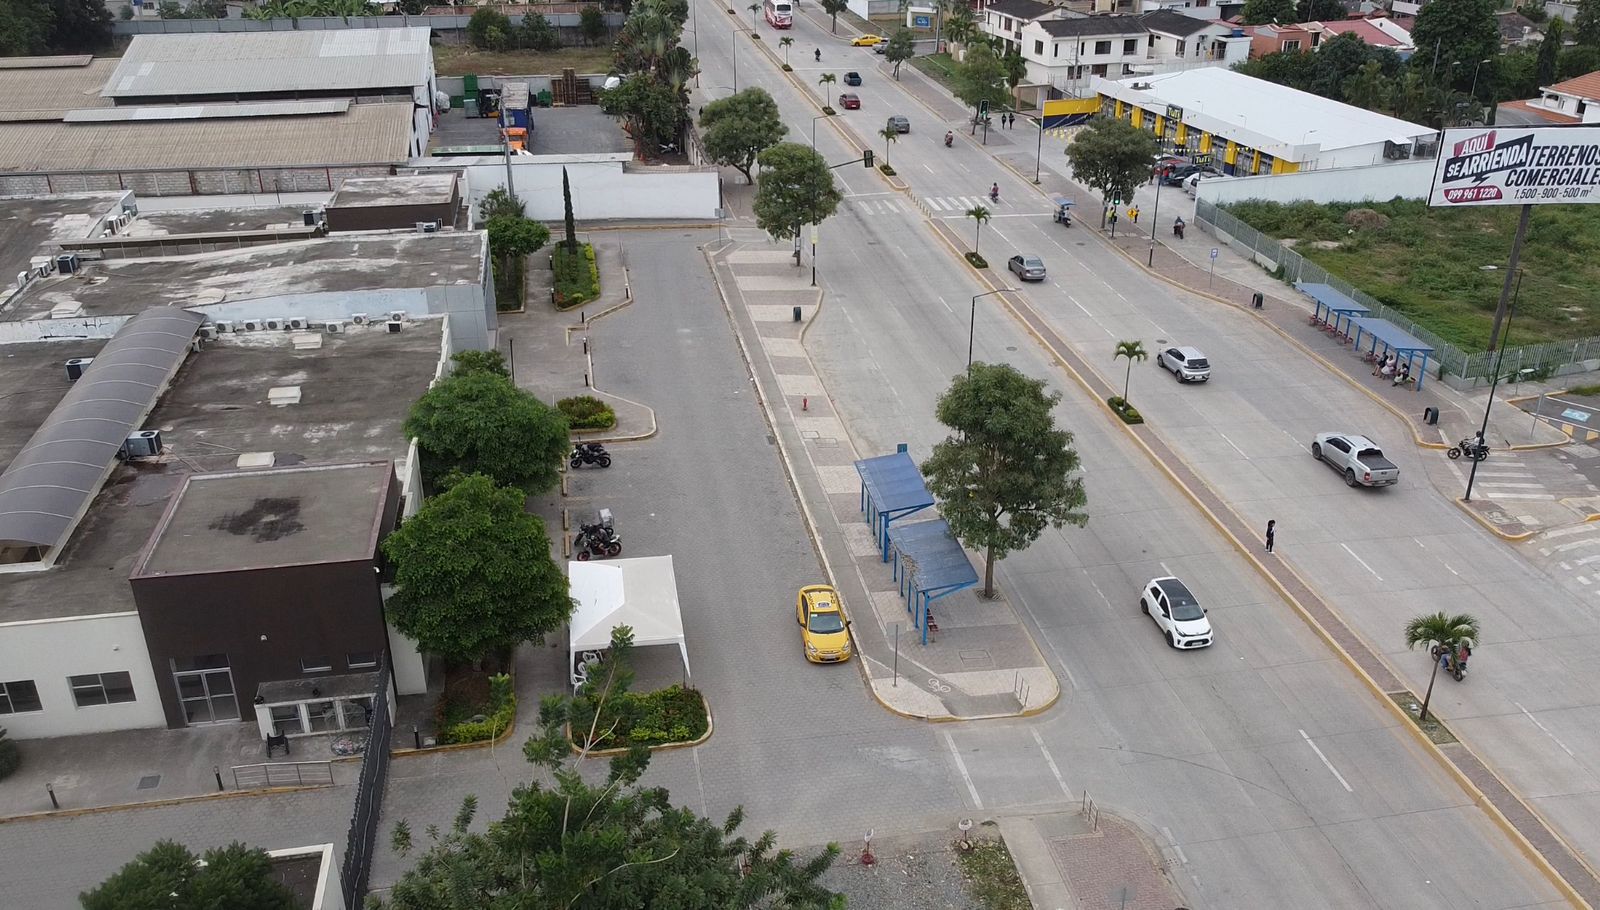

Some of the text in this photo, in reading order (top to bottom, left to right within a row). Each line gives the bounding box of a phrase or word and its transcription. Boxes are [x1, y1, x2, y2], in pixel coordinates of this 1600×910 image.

[1446, 142, 1528, 178] SE ARRIENDA
[1504, 167, 1600, 187] COMERCIALE
[1447, 187, 1498, 200] 099 961 1220
